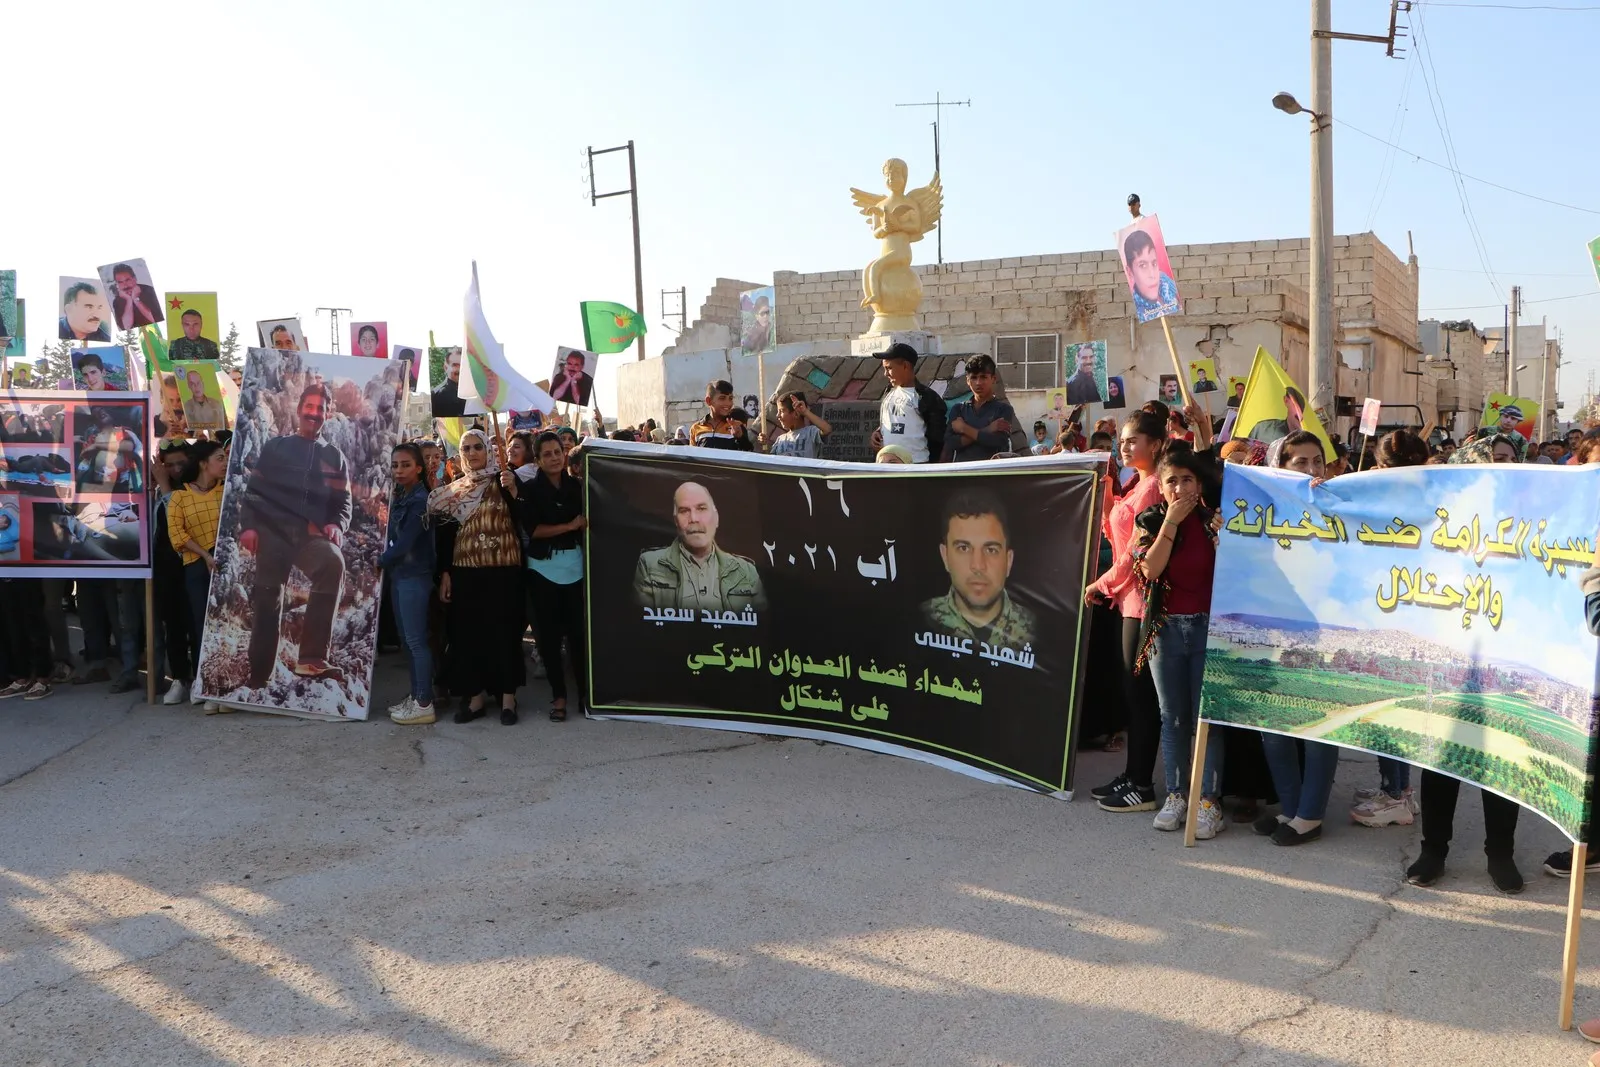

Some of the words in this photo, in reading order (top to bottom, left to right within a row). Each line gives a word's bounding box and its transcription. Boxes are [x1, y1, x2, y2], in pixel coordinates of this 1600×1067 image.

[1225, 498, 1348, 549] الخيانة
[1357, 516, 1422, 548] ضد
[1431, 508, 1532, 567] الكرامة
[763, 540, 837, 572] ٢٠٢١
[857, 538, 897, 586] آب
[1528, 517, 1596, 579] سيرة
[1376, 565, 1503, 631] والإحتلال
[643, 606, 695, 627] سعيد
[701, 603, 758, 629] شهيد
[686, 643, 762, 675] التركي
[914, 631, 973, 658] عيسى
[979, 641, 1035, 669] شهيد
[769, 648, 851, 680] العدوان
[858, 658, 908, 688] قصف
[780, 684, 843, 712] شنكال
[914, 668, 983, 705] شهداء
[850, 695, 890, 721] على
